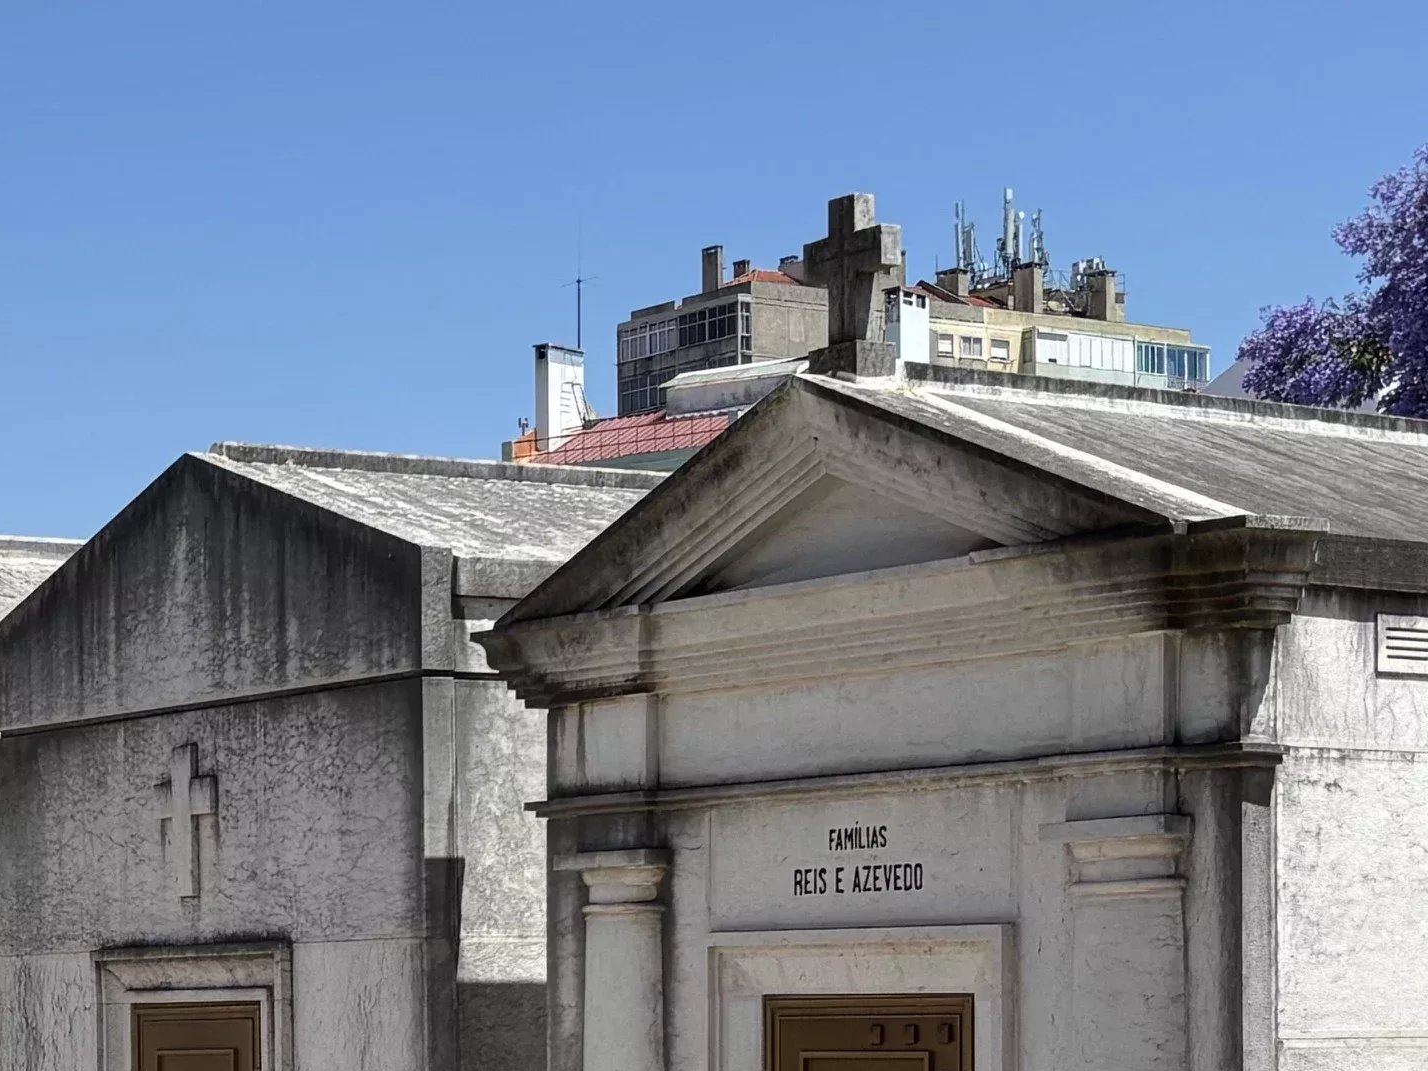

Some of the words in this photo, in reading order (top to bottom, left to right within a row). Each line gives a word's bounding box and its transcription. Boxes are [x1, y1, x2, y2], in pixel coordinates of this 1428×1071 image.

[828, 820, 888, 851] FAMÍLIAS
[793, 867, 828, 896] REIS
[835, 867, 845, 894] E
[852, 862, 924, 893] AZEVEDO
